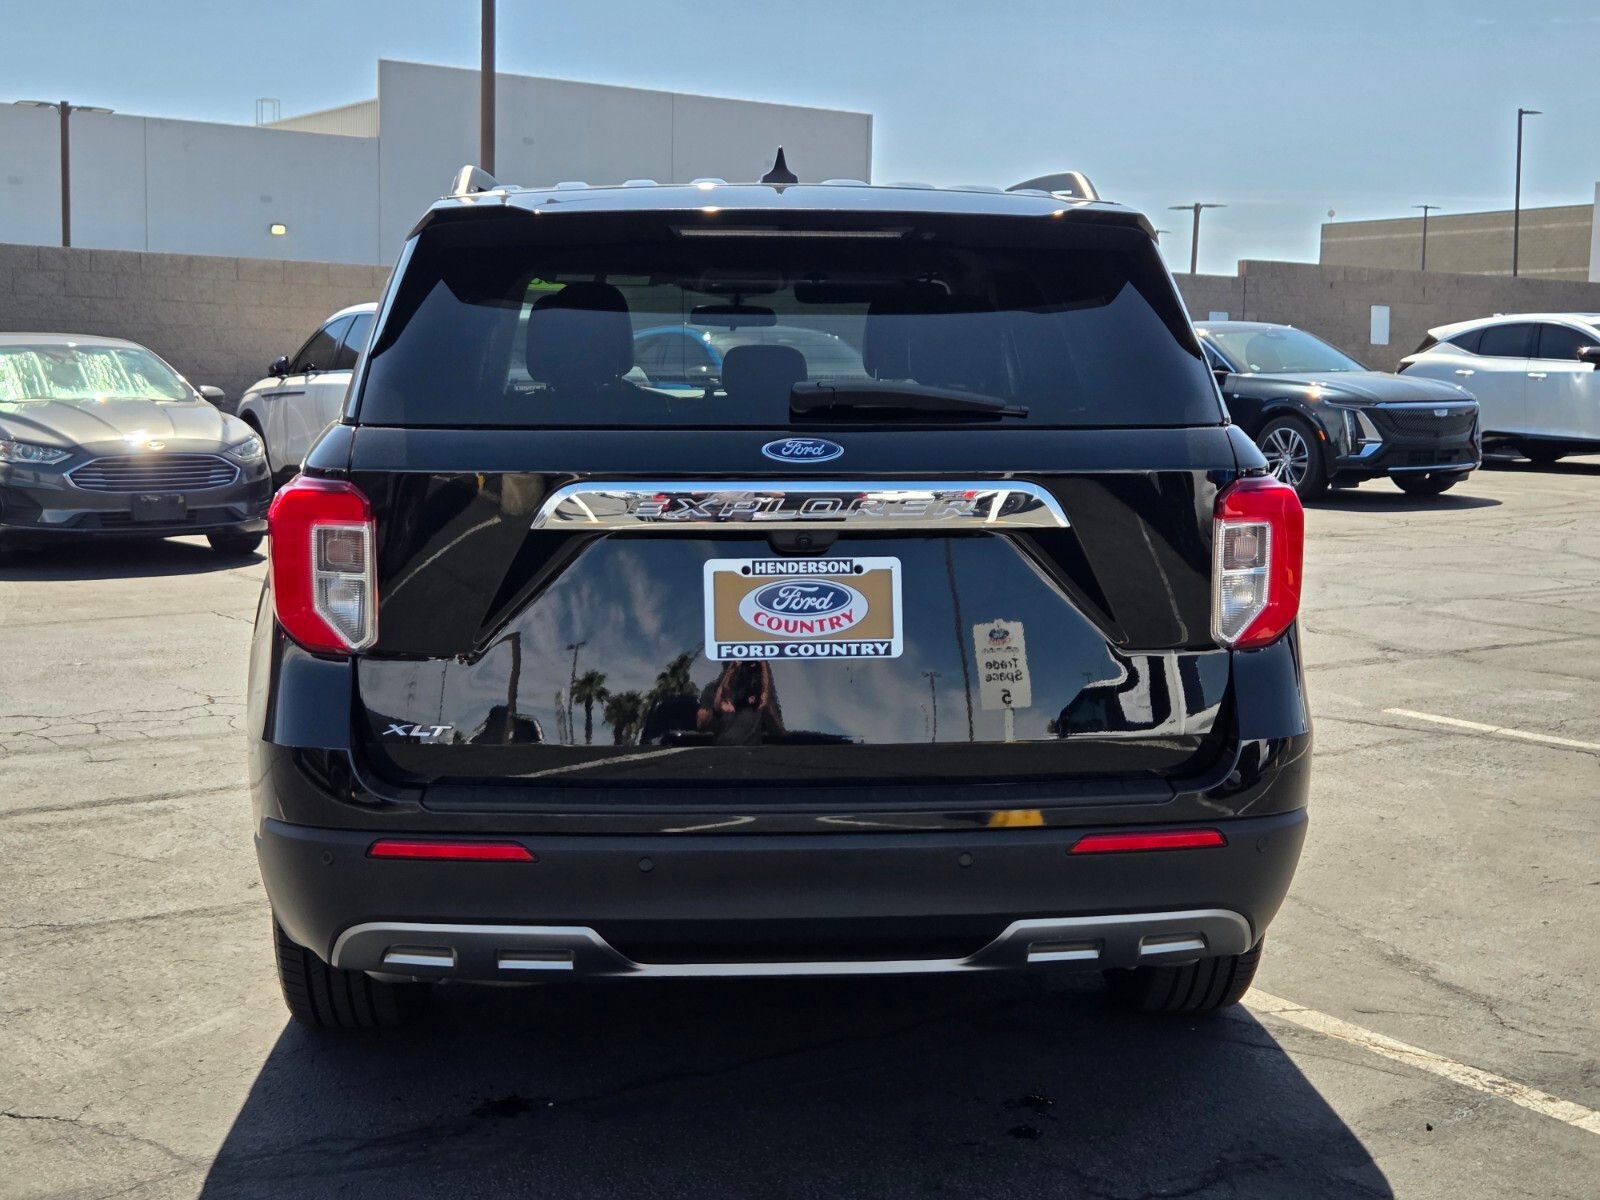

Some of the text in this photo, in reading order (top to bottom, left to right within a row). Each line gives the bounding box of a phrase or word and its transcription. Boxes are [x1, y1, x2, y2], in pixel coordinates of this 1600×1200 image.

[781, 440, 825, 455] Ford
[625, 498, 977, 518] EXPLORER
[755, 561, 850, 574] HENDERSON
[773, 586, 834, 609] Ford
[754, 609, 854, 634] COUNTRY
[721, 642, 888, 657] FORD COUNTRY
[382, 724, 453, 737] XLT
